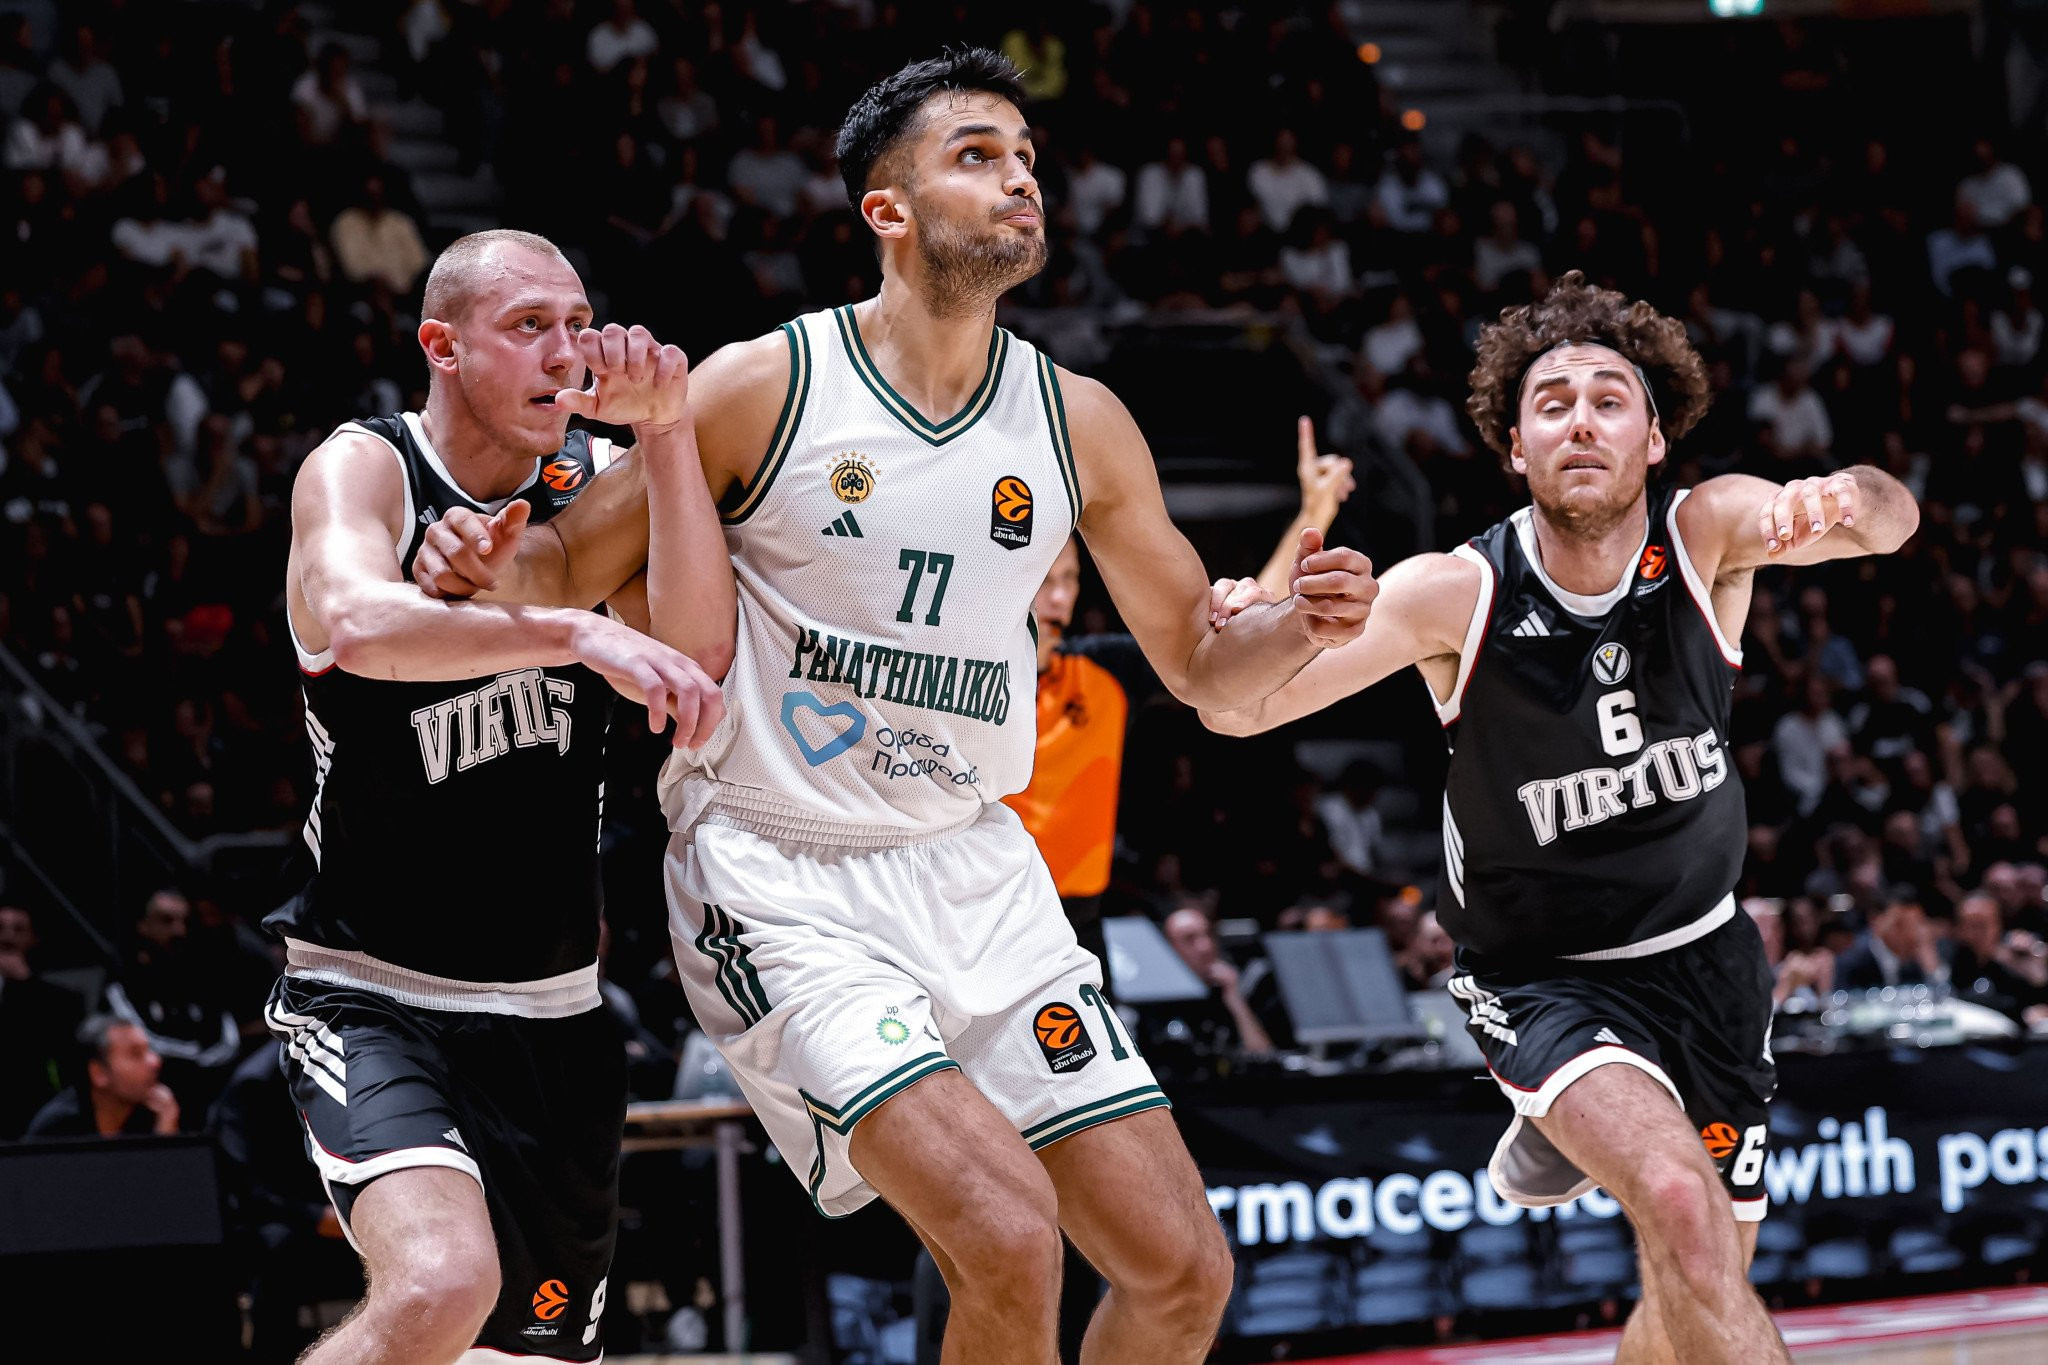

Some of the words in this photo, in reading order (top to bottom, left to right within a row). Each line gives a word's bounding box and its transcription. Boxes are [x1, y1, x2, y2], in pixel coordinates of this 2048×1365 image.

[896, 548, 954, 626] 77
[1596, 689, 1644, 757] 6
[1517, 727, 1728, 846] VIRTUS
[885, 1005, 899, 1016] bp
[1079, 984, 1143, 1061] 7
[1054, 1059, 1070, 1071] abu
[1070, 1047, 1093, 1063] dhabi
[1730, 1124, 1767, 1186] 6
[1764, 1105, 1916, 1206] with
